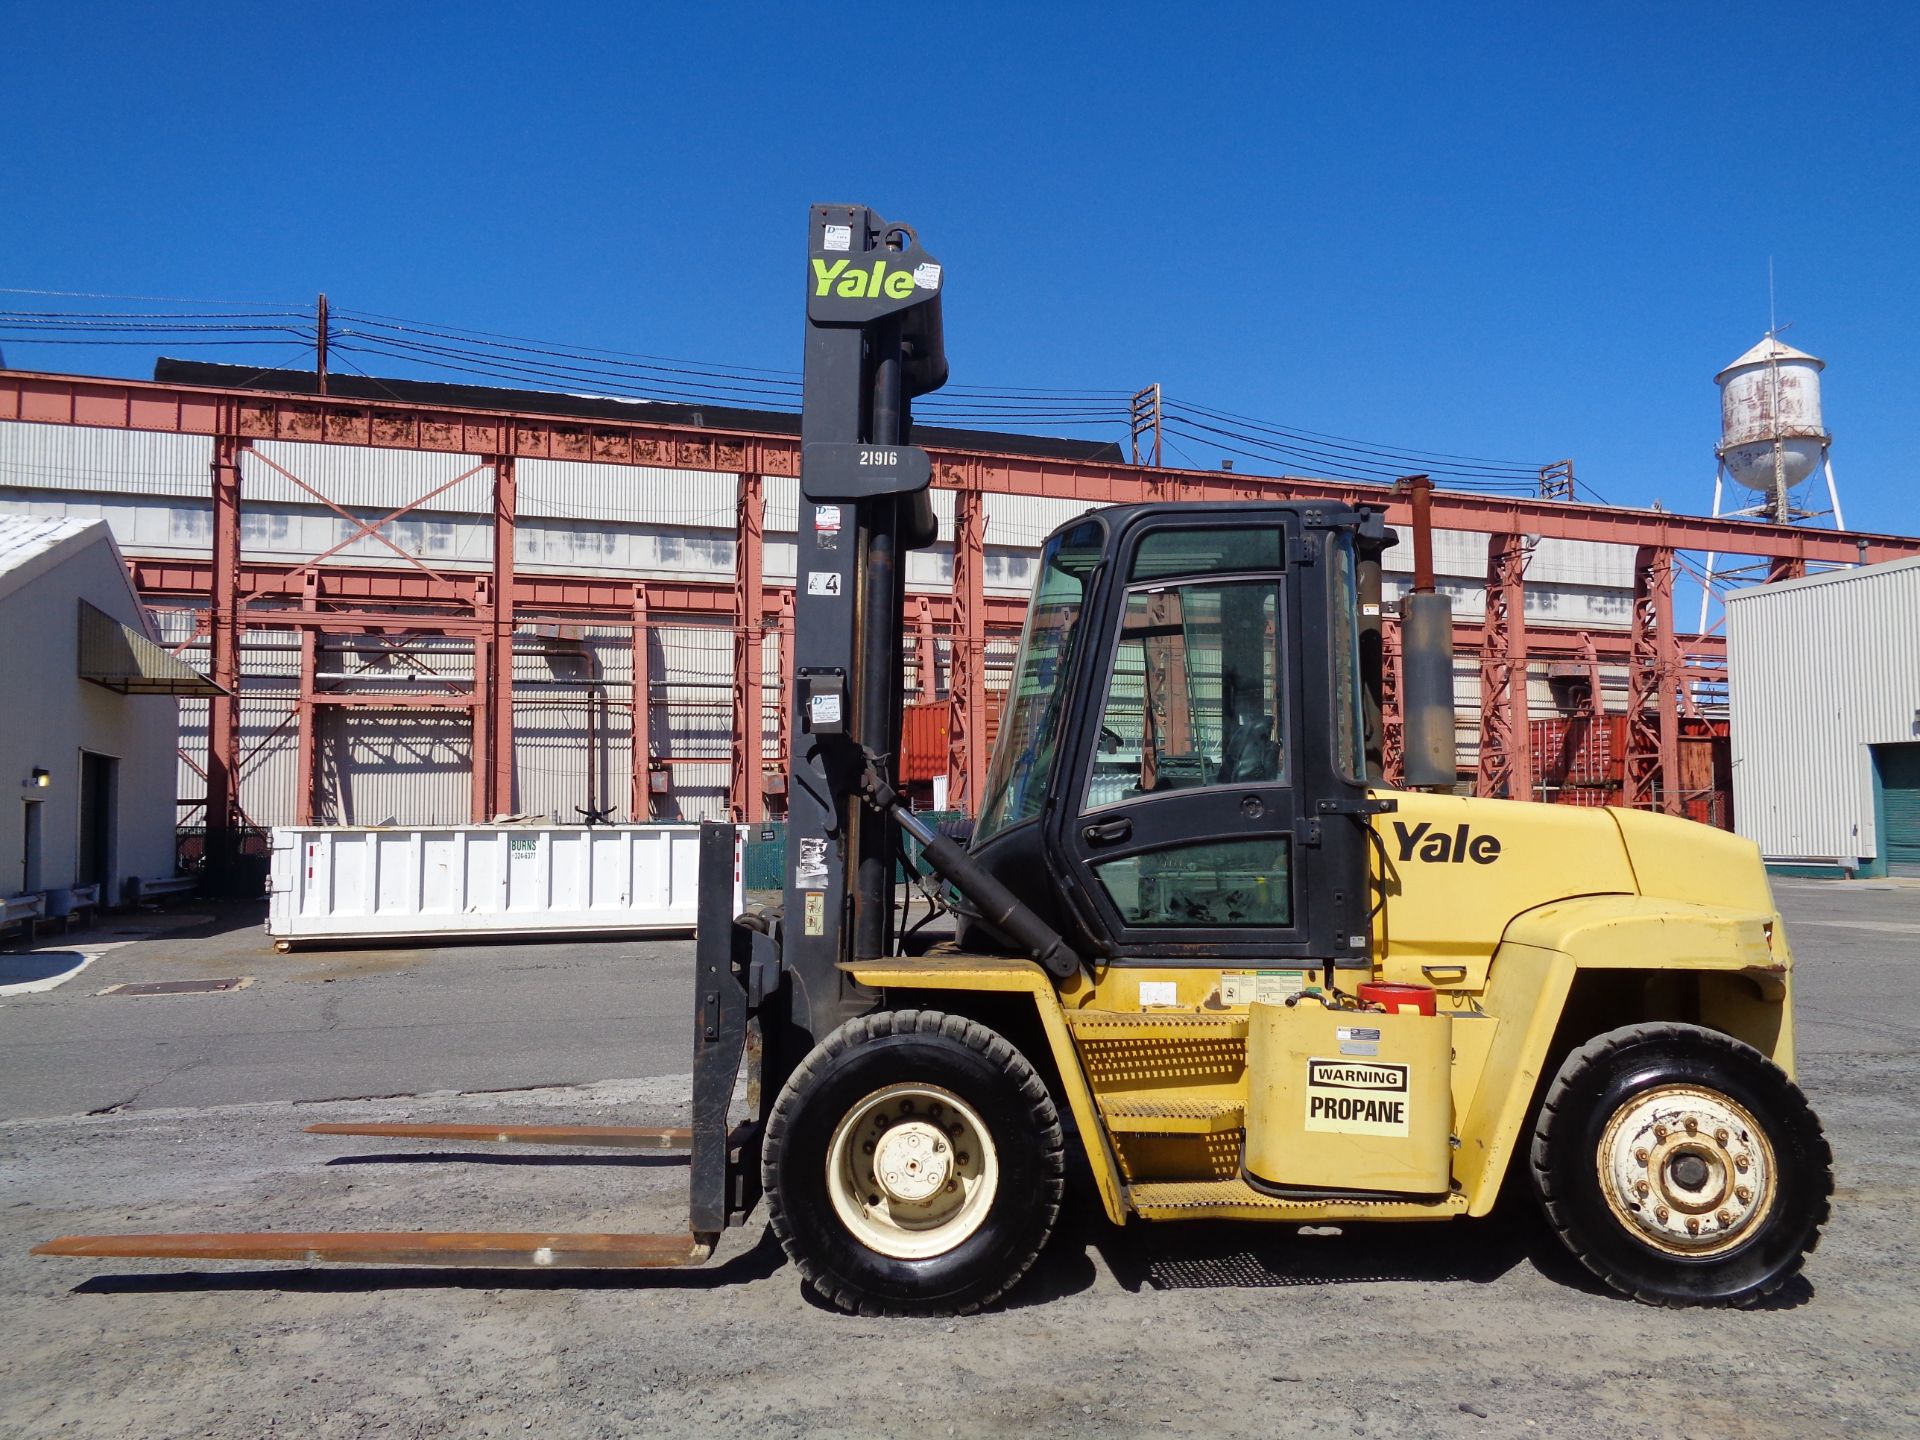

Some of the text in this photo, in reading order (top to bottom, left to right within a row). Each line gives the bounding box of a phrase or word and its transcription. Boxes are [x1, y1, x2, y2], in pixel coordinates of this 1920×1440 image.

[812, 259, 915, 299] Yale
[859, 451, 898, 466] 21916
[511, 840, 537, 851] BURNS
[1392, 821, 1501, 865] Yale
[1318, 1068, 1398, 1085] WARNING
[1310, 1096, 1404, 1124] PROPANE
